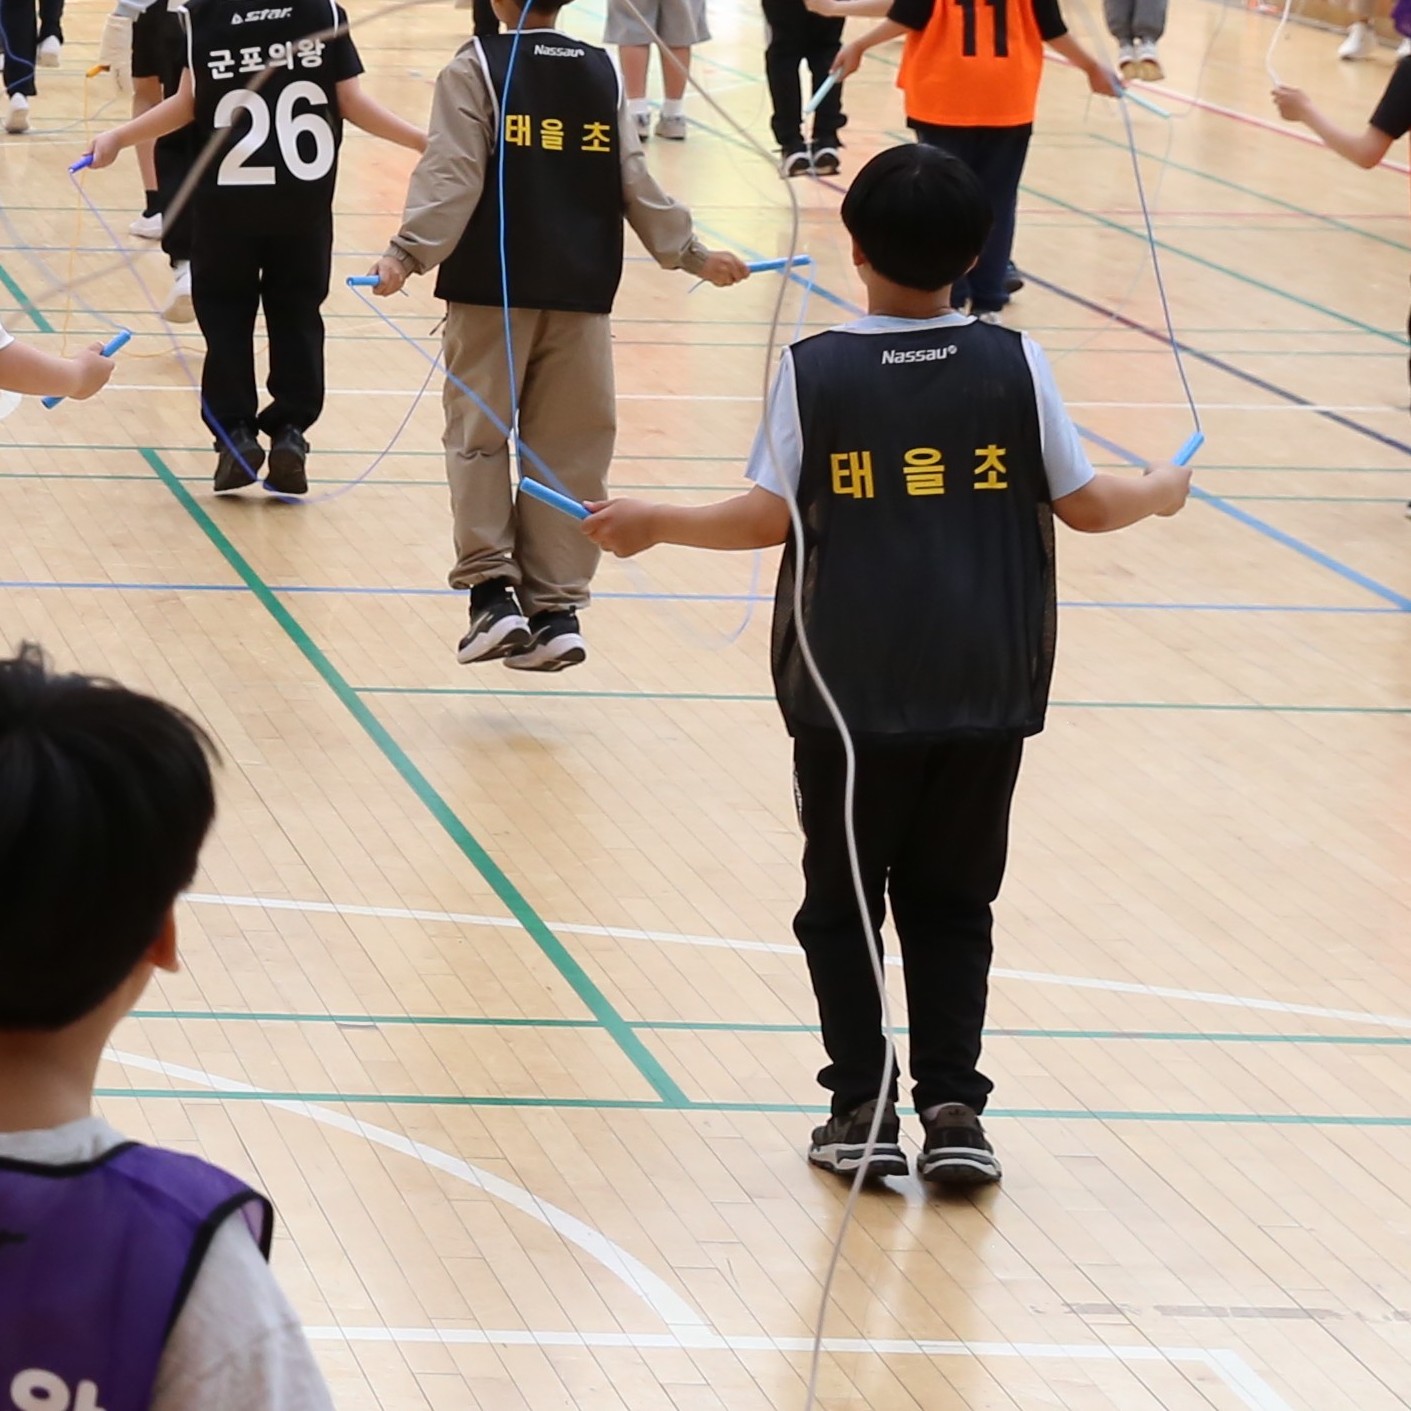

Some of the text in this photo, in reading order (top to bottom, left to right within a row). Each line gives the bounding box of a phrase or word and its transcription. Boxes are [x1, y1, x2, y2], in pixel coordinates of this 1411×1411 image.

[208, 39, 325, 80] 군포의왕
[214, 80, 335, 186] 26
[505, 114, 612, 153] 태을초
[881, 347, 948, 366] Nassau
[830, 444, 1009, 500] 태을초
